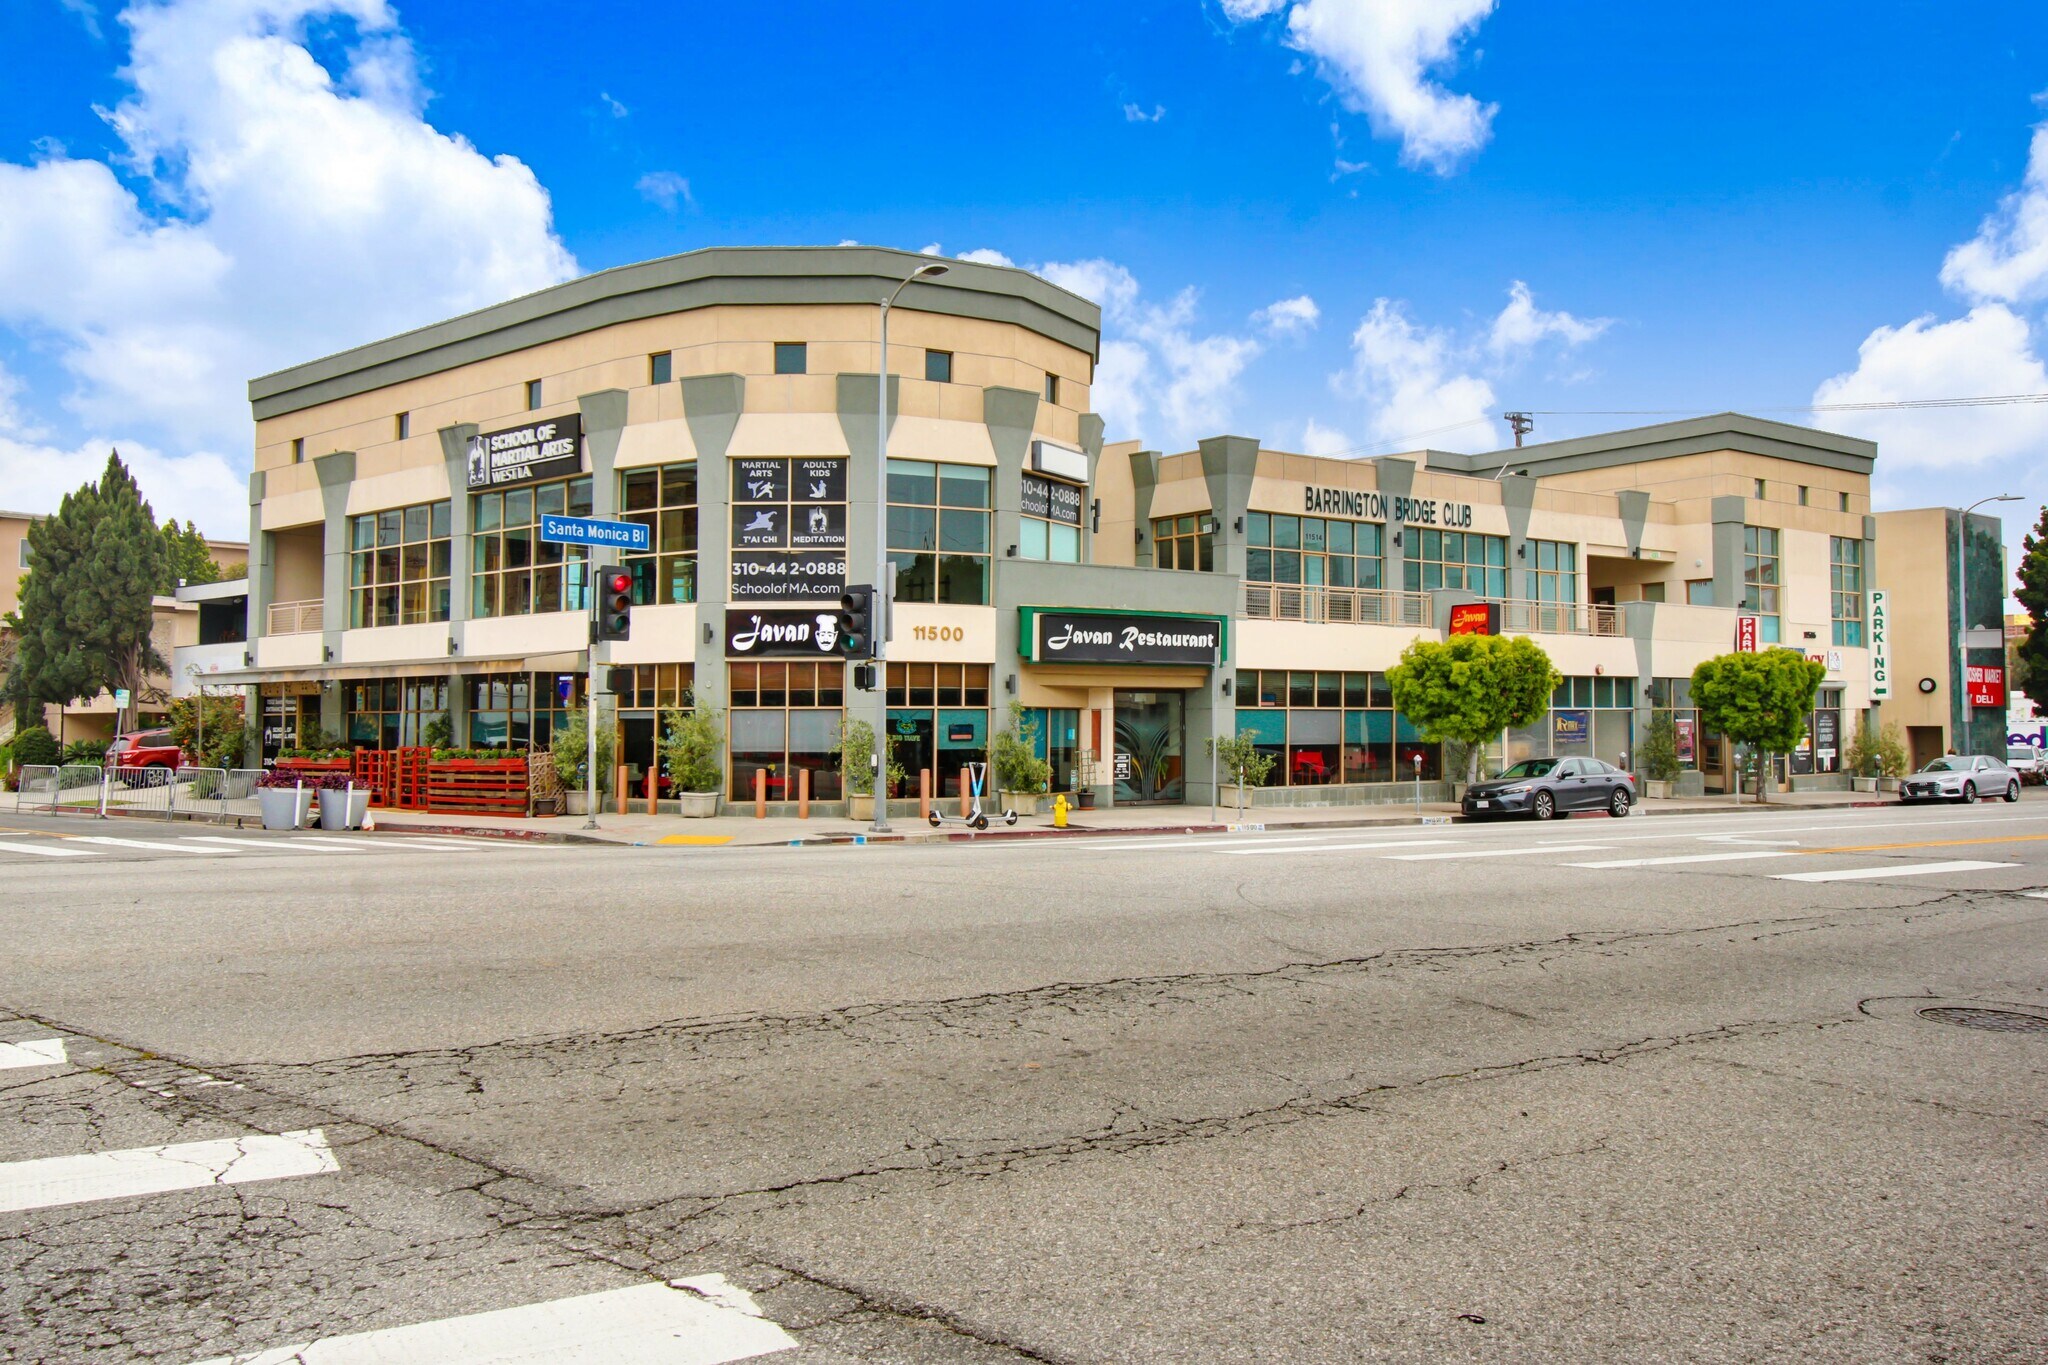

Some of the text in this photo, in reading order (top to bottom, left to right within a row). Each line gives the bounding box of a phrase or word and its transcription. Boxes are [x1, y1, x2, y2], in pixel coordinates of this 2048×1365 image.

[491, 424, 556, 451] SCHOOL OF
[491, 438, 574, 468] MARTIAL ARTS
[741, 461, 781, 469] MARTIAL
[749, 469, 773, 477] ARTS
[803, 461, 838, 469] ADULTS
[809, 469, 831, 477] KIDS
[492, 467, 517, 484] WEST
[1020, 479, 1081, 507] 10-442-0888
[1305, 486, 1472, 528] BARRINGTON BRIDGE CLUB
[548, 520, 644, 543] Santa Monica Bl
[743, 535, 778, 543] T'AI CHI
[793, 535, 845, 543] MEDITATION
[1305, 533, 1323, 542] 11514
[1452, 609, 1486, 628] Javan
[732, 614, 810, 651] Javan
[912, 625, 964, 641] 11500
[1047, 624, 1214, 652] Javan Restaurant
[1873, 592, 1886, 682] PARKING
[1984, 668, 2002, 683] MARKET
[1981, 684, 1987, 693] &
[1975, 694, 1994, 704] DELI
